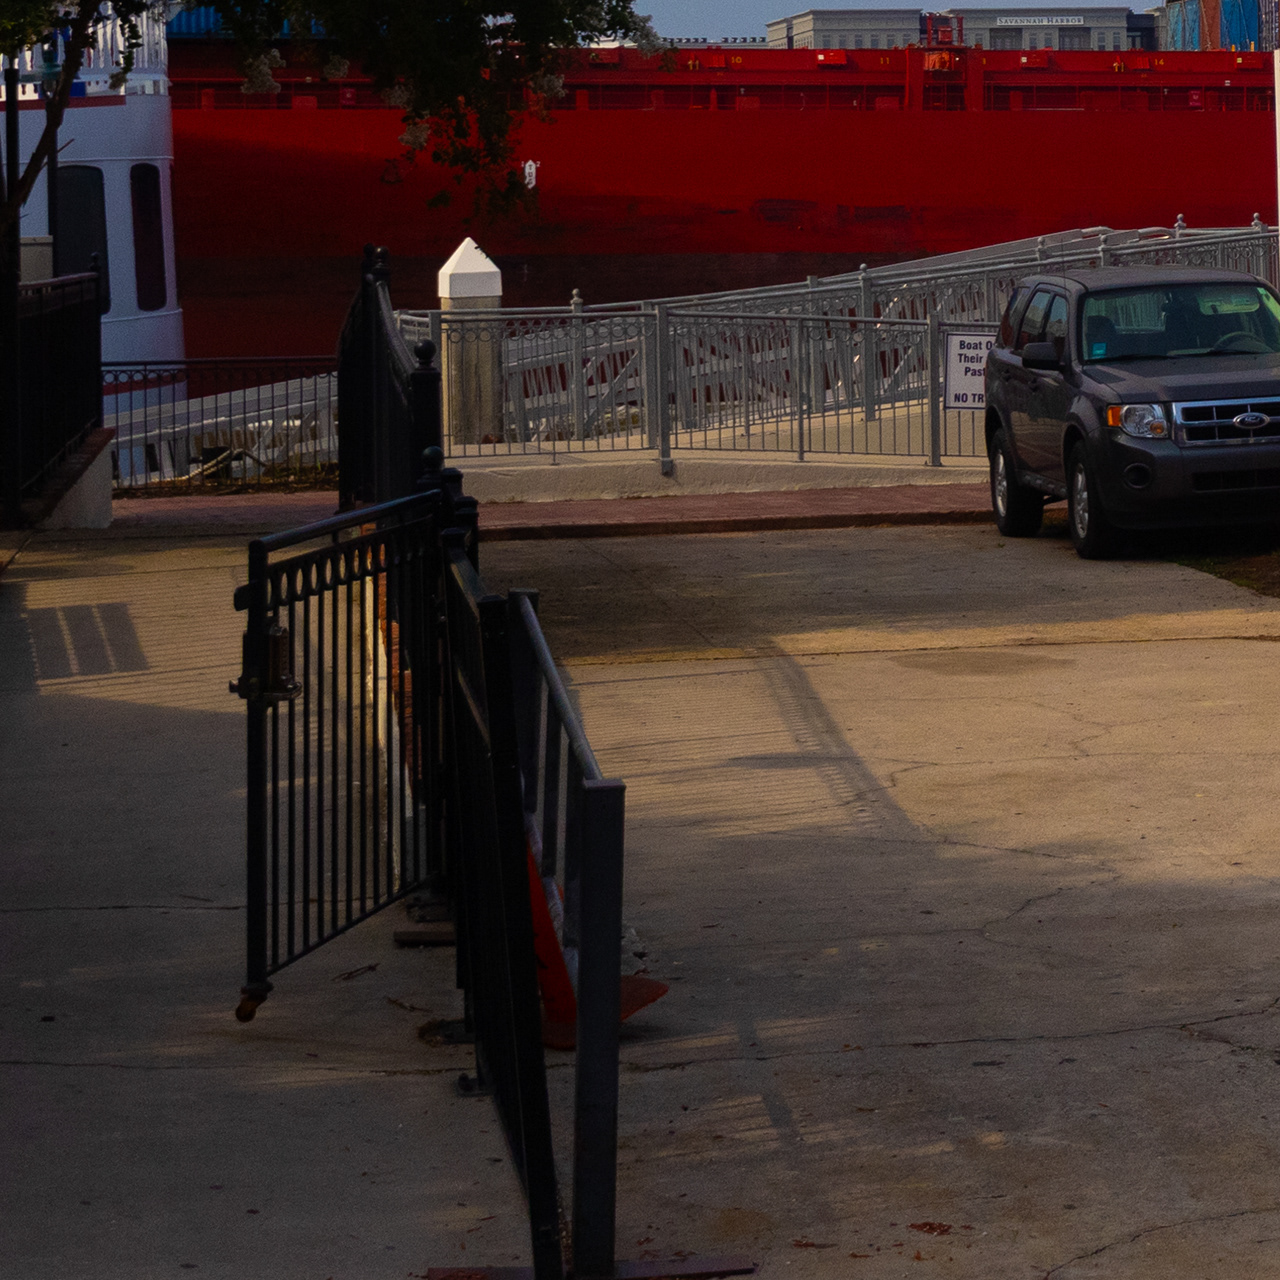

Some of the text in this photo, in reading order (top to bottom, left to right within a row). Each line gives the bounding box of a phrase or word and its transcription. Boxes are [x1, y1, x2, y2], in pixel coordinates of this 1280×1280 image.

[959, 340, 983, 351] Boat
[958, 353, 983, 363] Their
[954, 393, 985, 403] NO TR
